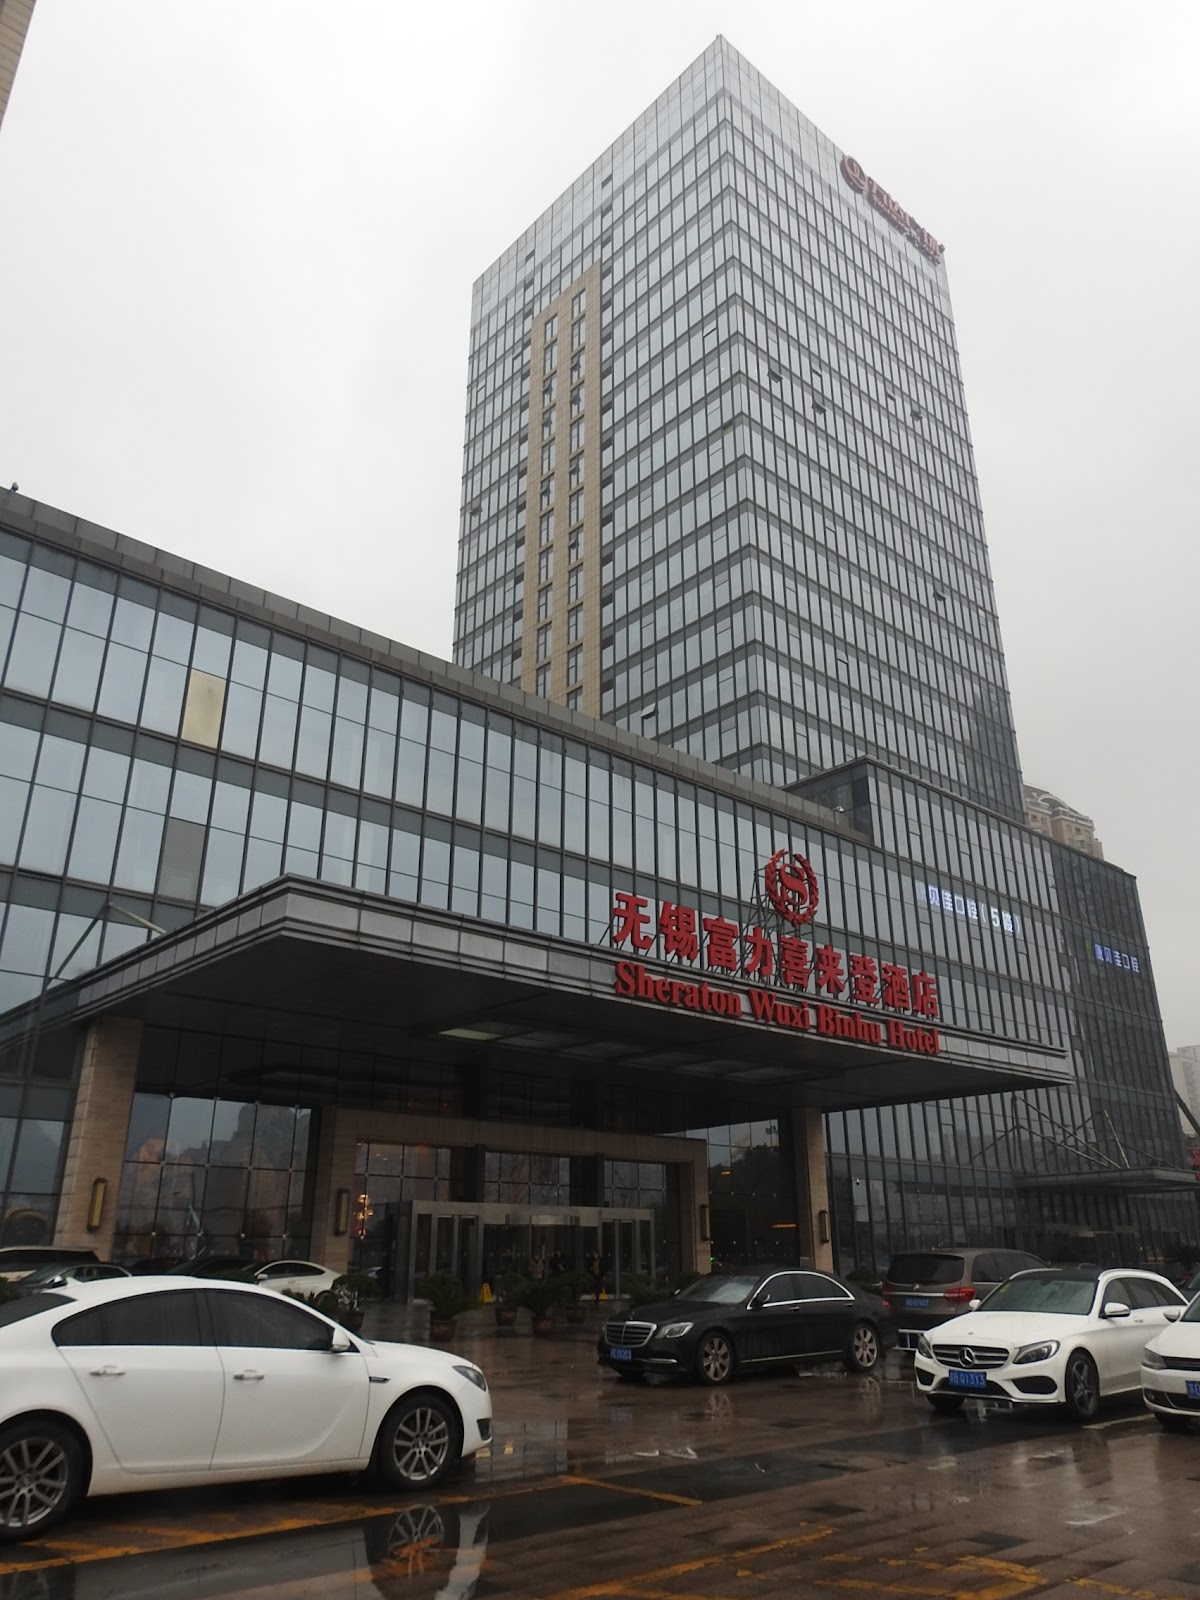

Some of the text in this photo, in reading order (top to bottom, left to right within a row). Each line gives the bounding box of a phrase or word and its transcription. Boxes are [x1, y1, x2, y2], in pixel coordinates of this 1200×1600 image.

[612, 892, 939, 1017] 无锡富力喜来登酒店
[615, 960, 941, 1055] Sheraton Wuxi Binhu Hotel
